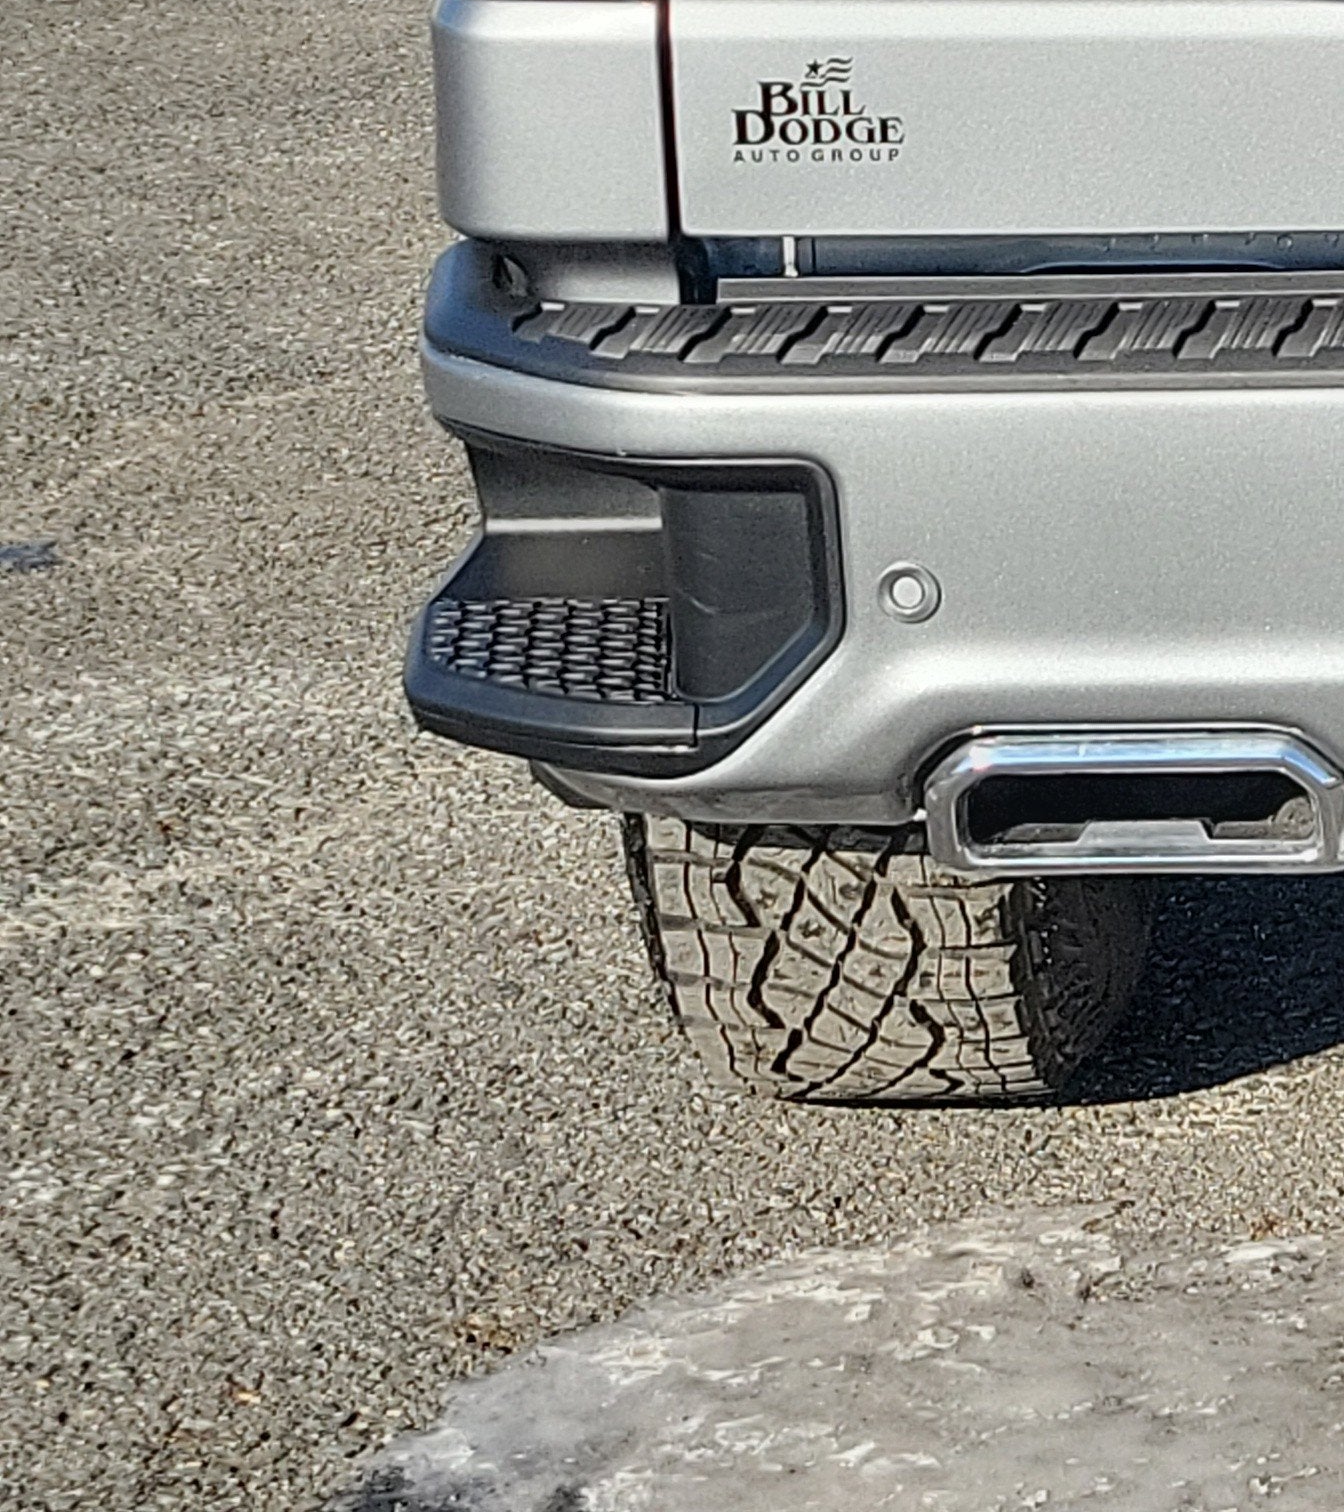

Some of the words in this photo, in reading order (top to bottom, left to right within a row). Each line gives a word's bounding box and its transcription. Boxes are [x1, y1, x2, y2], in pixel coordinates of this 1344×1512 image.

[757, 81, 867, 117] BILL
[731, 108, 906, 146] DODGE
[733, 148, 801, 163] AUTO
[811, 148, 900, 163] GROUP
